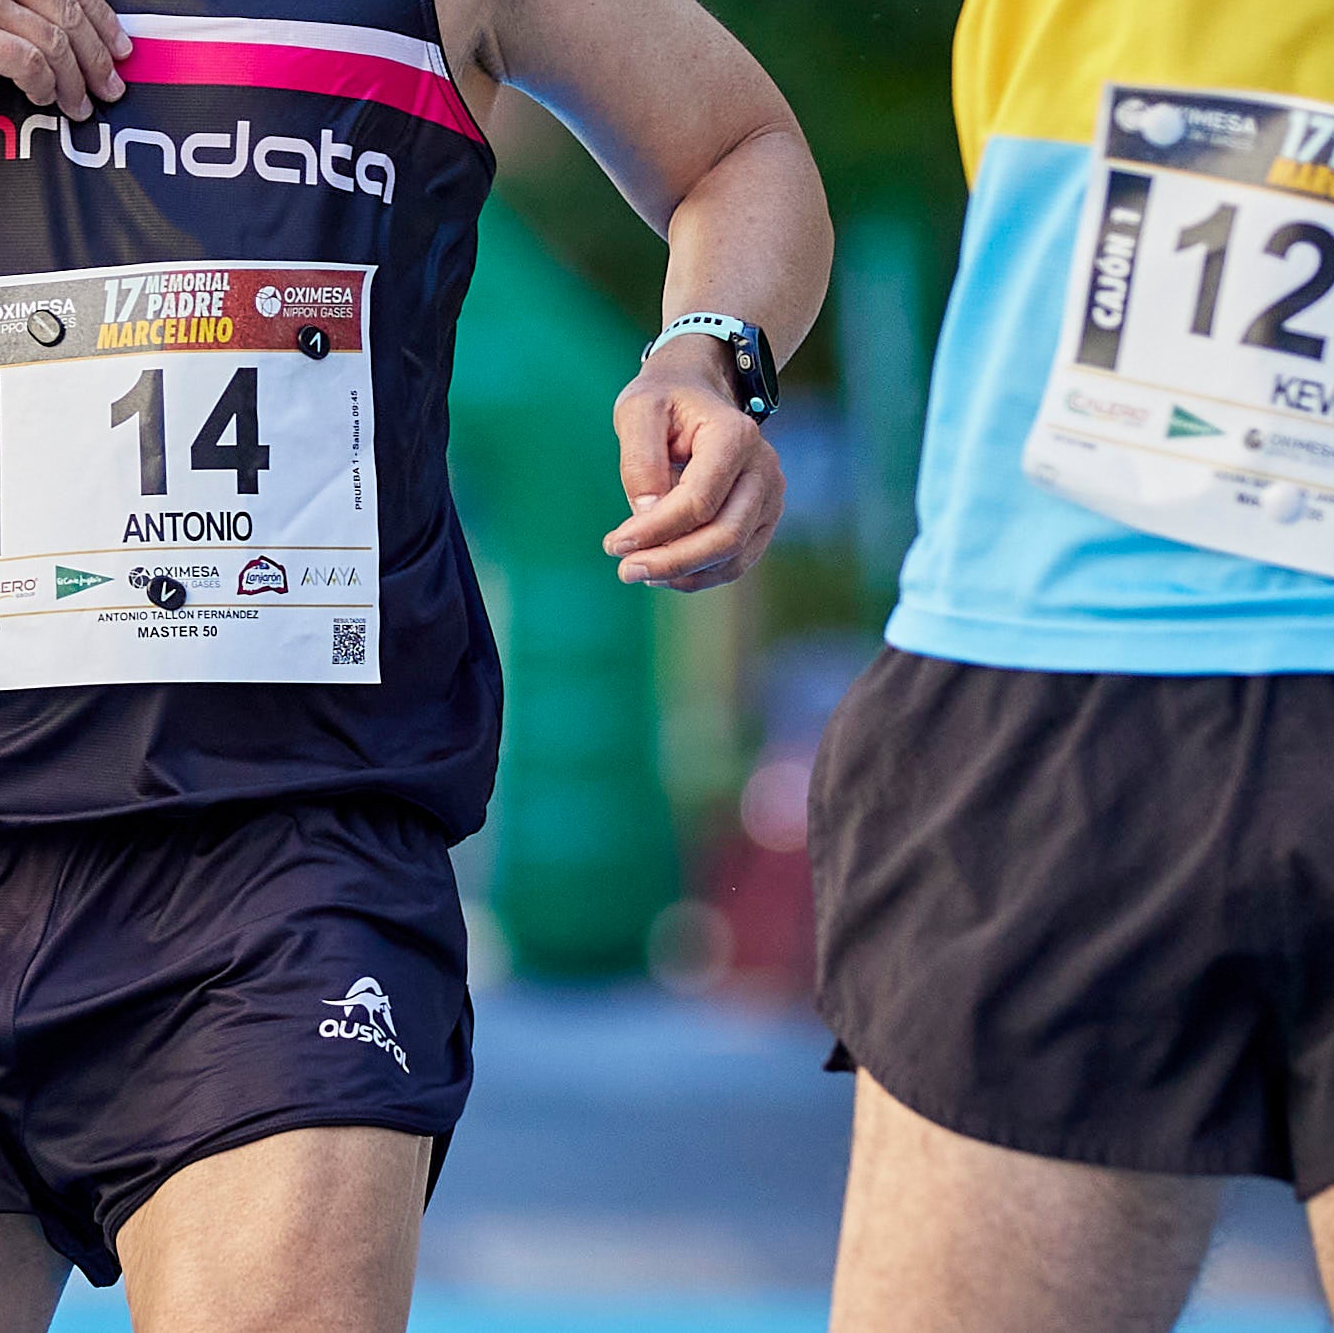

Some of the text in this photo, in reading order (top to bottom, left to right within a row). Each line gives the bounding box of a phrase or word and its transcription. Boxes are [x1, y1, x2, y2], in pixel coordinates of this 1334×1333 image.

[145, 272, 230, 294] MEMORIAL
[104, 276, 145, 324] 17
[146, 291, 224, 319] PADRE
[284, 287, 353, 304] OXIMESA
[283, 307, 353, 318] NIPPON GASES
[96, 317, 234, 349] MARCELINO
[110, 367, 270, 496] 14
[352, 419, 360, 450] Salida
[352, 467, 362, 510] PRUEBA
[123, 511, 253, 543] ANTONIO
[154, 566, 220, 578] OXIMESA
[246, 571, 282, 585] Lanjarón
[300, 567, 362, 586] ANAYA
[191, 580, 220, 588] GASES
[98, 608, 259, 622] ANTONIO TALLÓN FERNÁNDEZ
[137, 625, 218, 639] MASTER 50
[318, 1019, 410, 1074] austral
